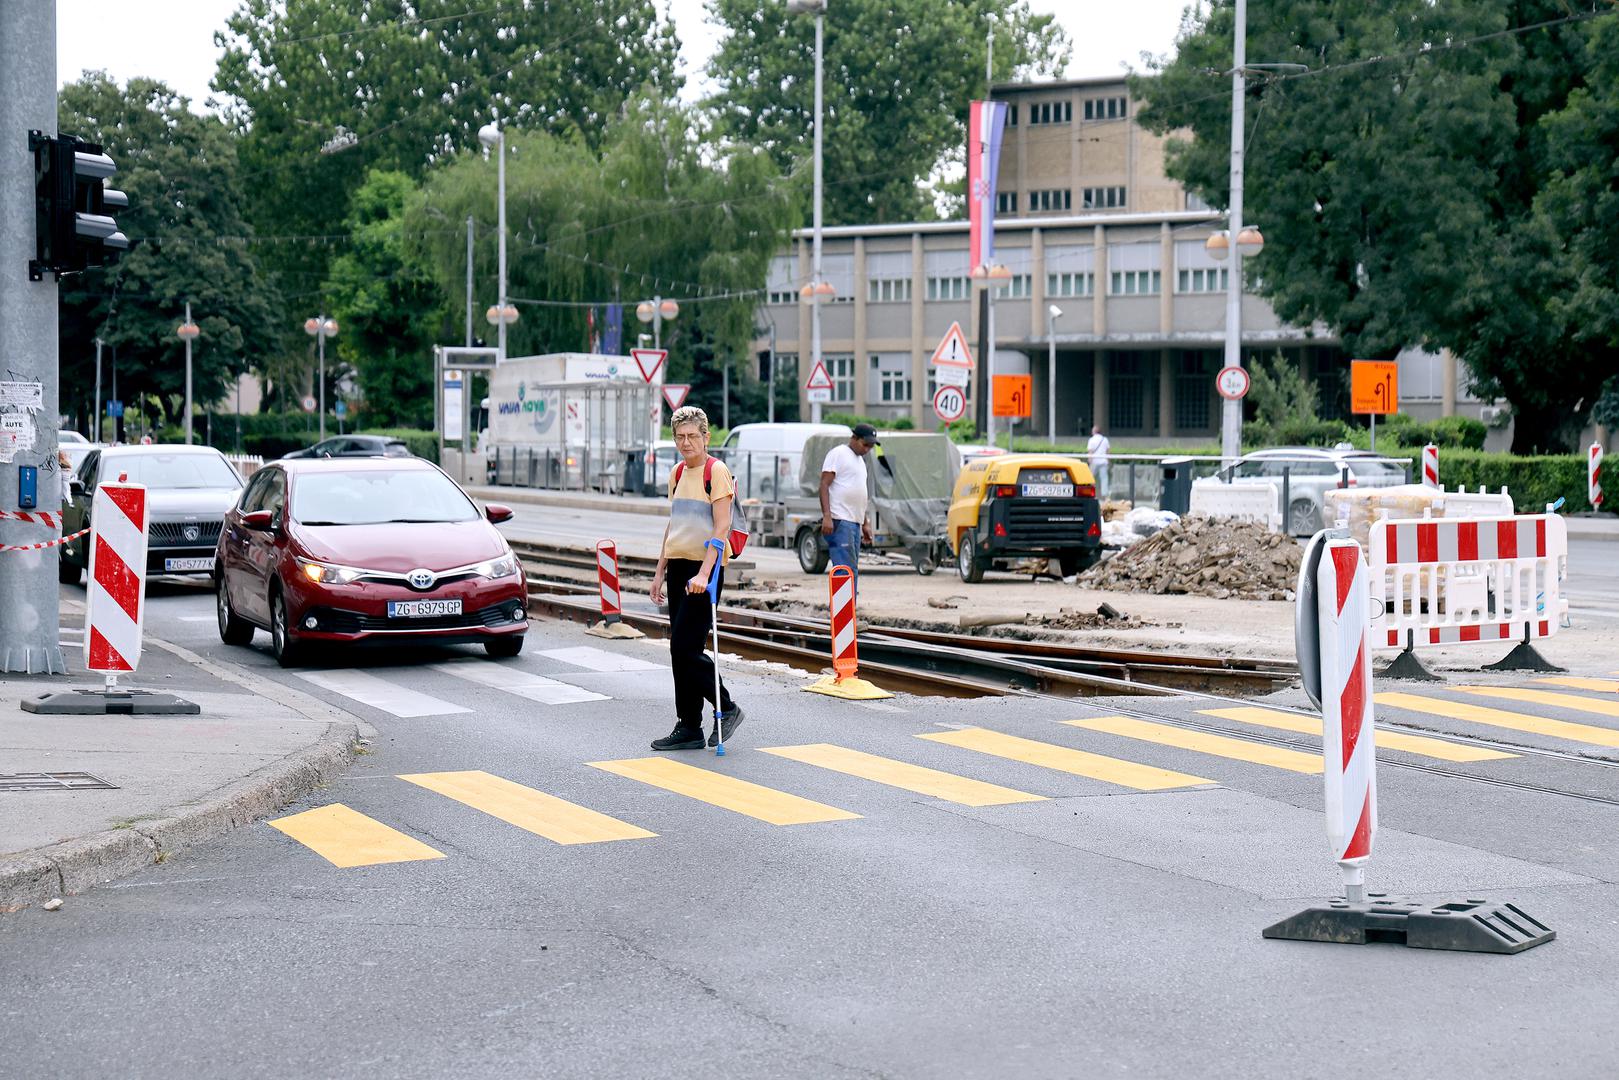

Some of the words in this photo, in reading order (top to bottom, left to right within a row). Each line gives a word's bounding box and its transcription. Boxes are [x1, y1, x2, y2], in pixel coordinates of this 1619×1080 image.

[940, 394, 958, 412] 40
[1029, 486, 1038, 495] ZG
[171, 560, 182, 570] ZG
[396, 603, 410, 615] ZG
